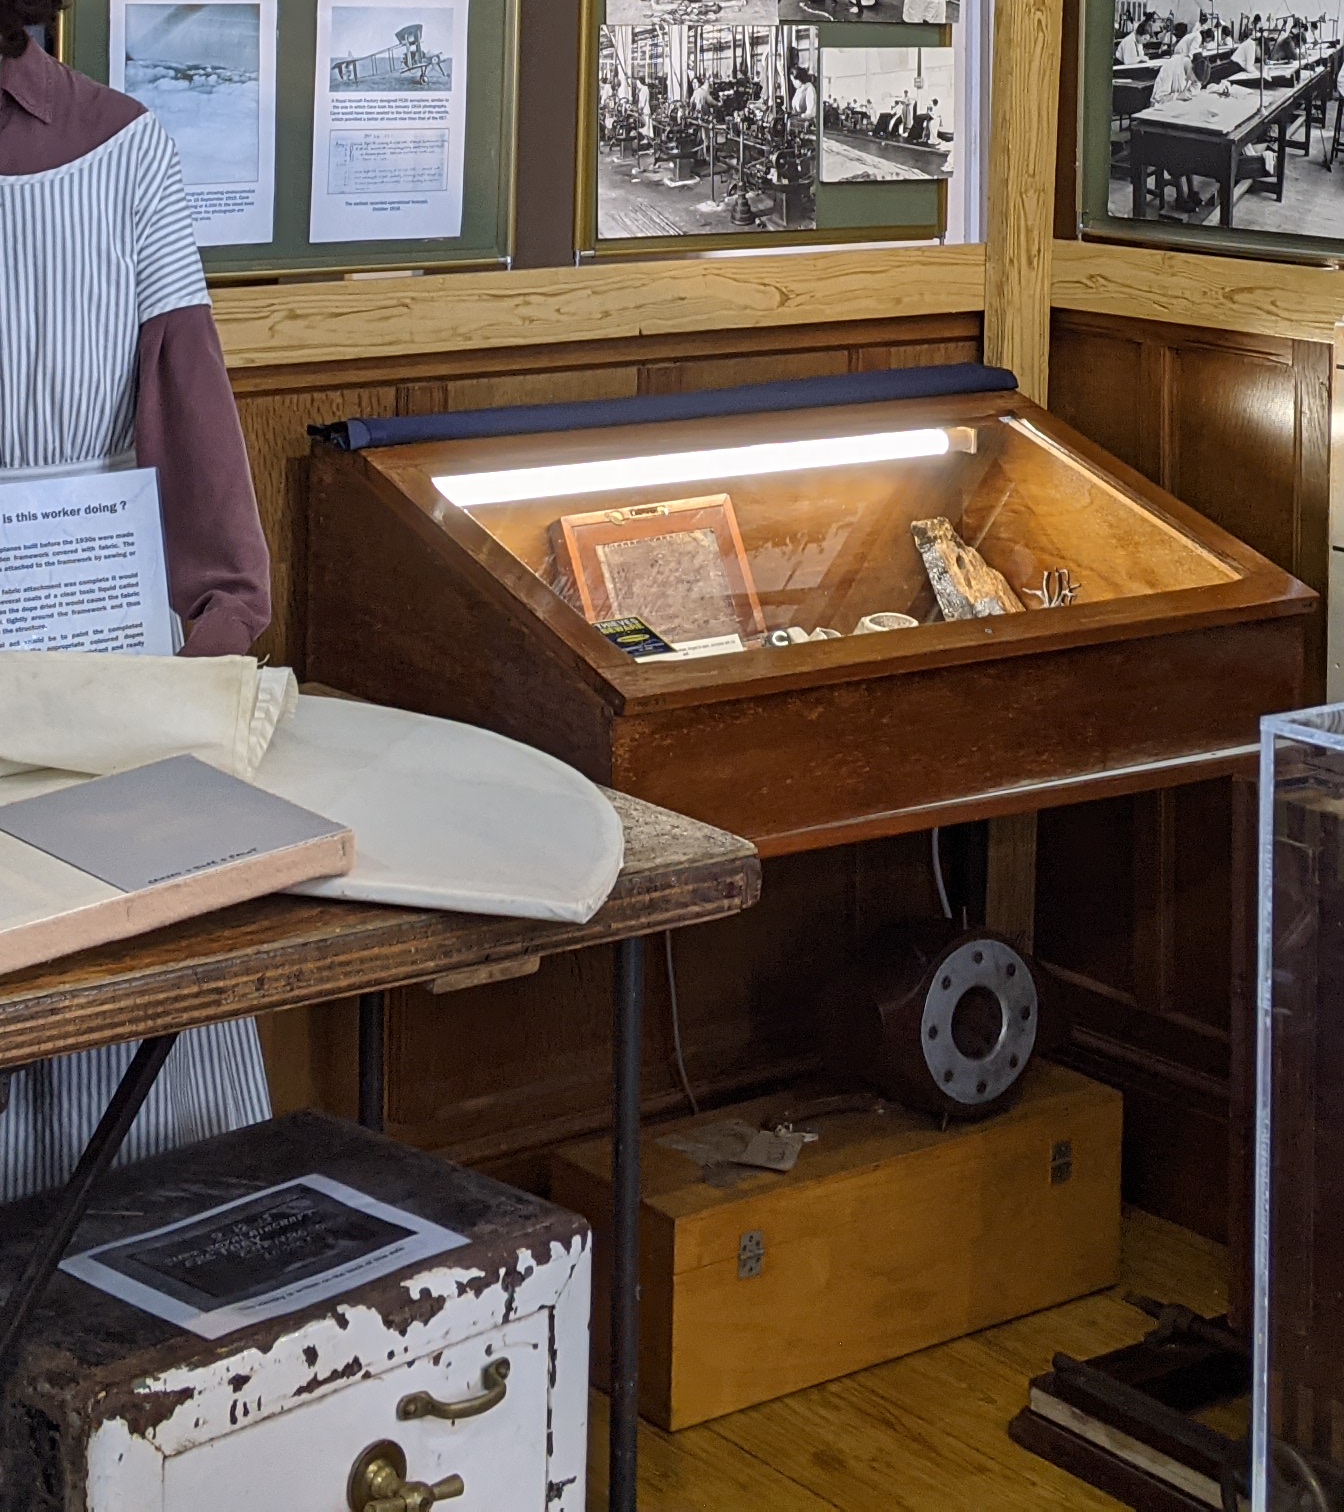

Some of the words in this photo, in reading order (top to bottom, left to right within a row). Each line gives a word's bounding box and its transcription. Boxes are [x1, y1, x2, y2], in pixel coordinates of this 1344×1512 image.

[2, 513, 12, 524] is
[15, 511, 37, 523] this
[40, 507, 80, 520] worker
[84, 503, 117, 515] doing
[120, 500, 127, 512] ?
